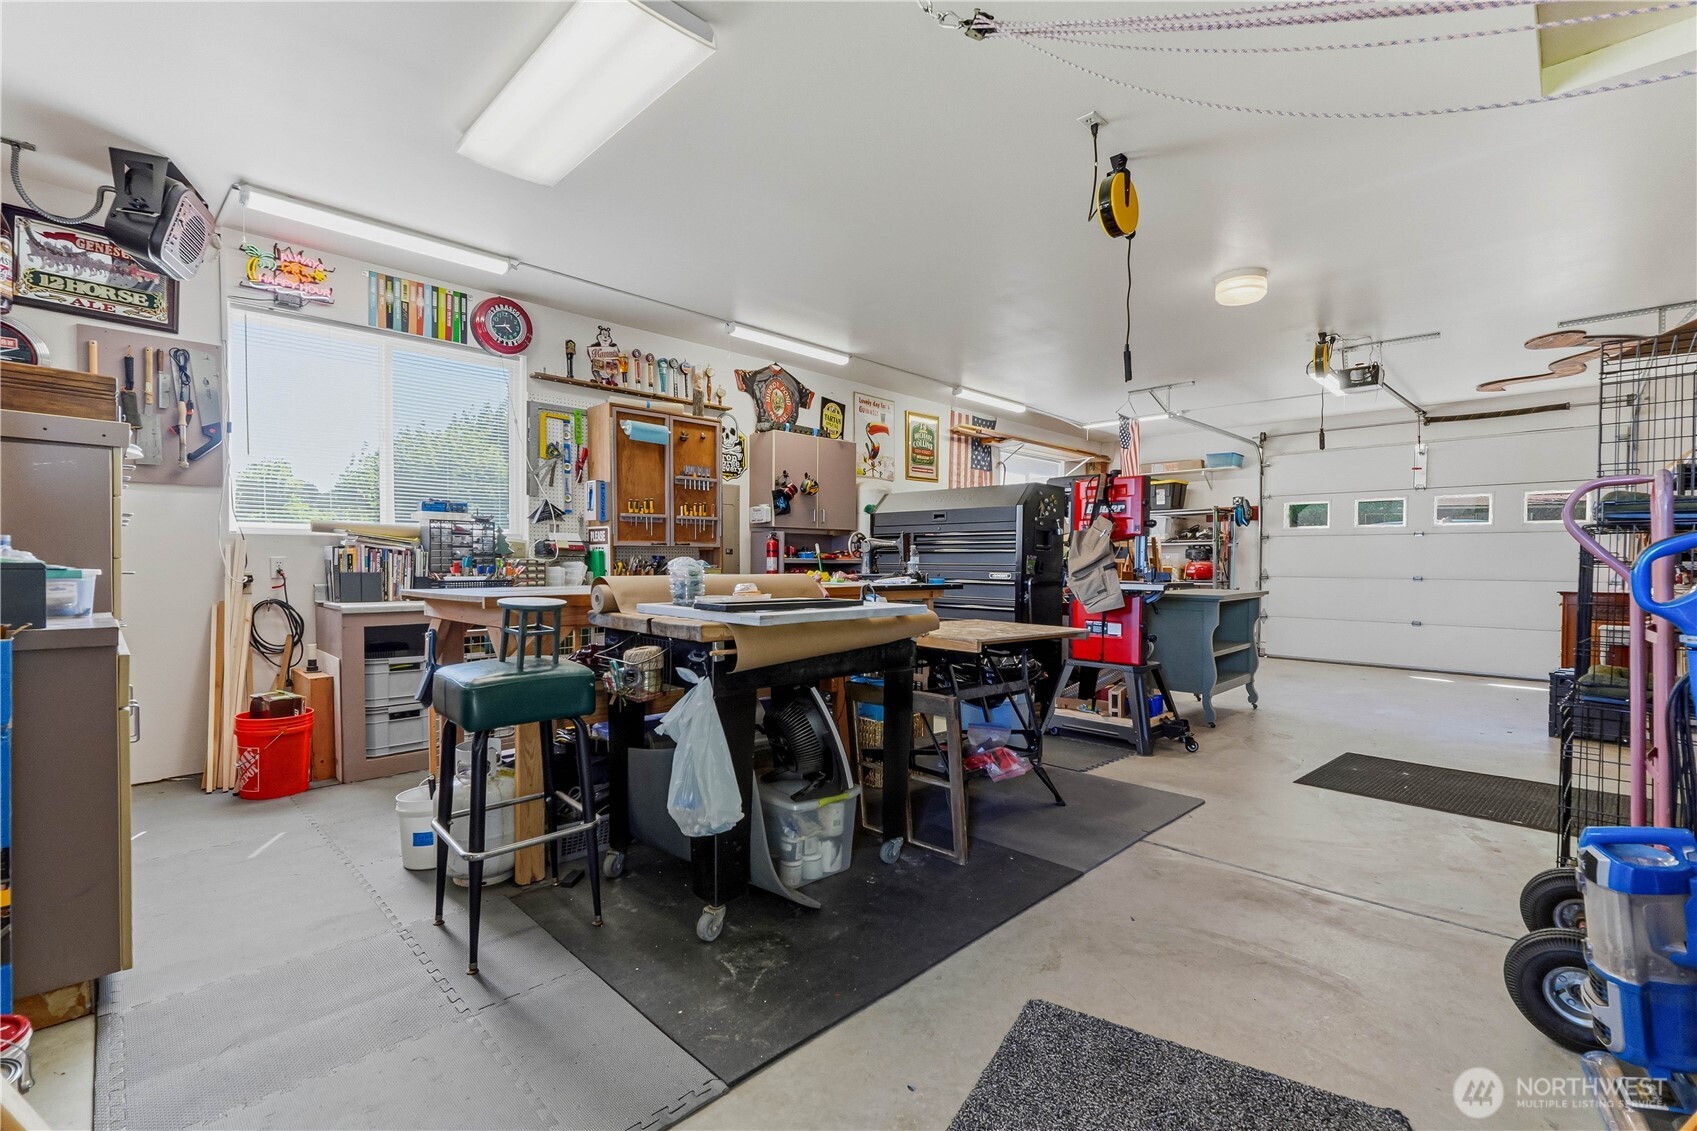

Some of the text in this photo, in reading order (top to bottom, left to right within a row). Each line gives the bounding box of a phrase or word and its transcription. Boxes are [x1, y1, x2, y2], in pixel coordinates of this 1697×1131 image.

[40, 273, 149, 306] 12 HORSE
[299, 283, 331, 298] HOUR
[69, 297, 117, 314] ALE
[780, 386, 792, 406] POND
[590, 530, 606, 541] PLEASE
